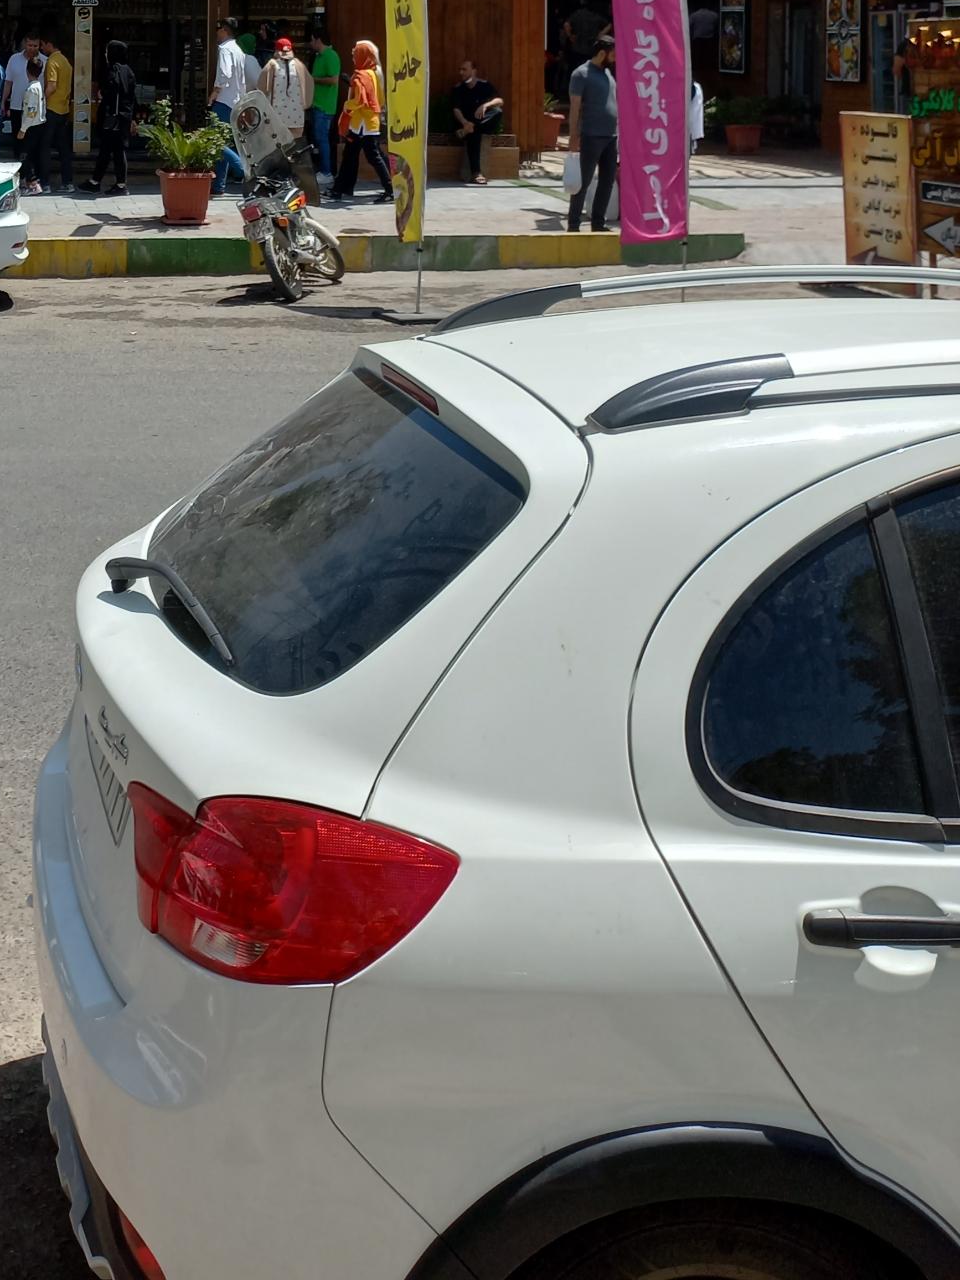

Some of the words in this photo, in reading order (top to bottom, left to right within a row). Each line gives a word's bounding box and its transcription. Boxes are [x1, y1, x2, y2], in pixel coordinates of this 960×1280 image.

[392, 50, 422, 93] حاضر
[390, 112, 419, 143] است
[642, 165, 670, 233] اصیل
